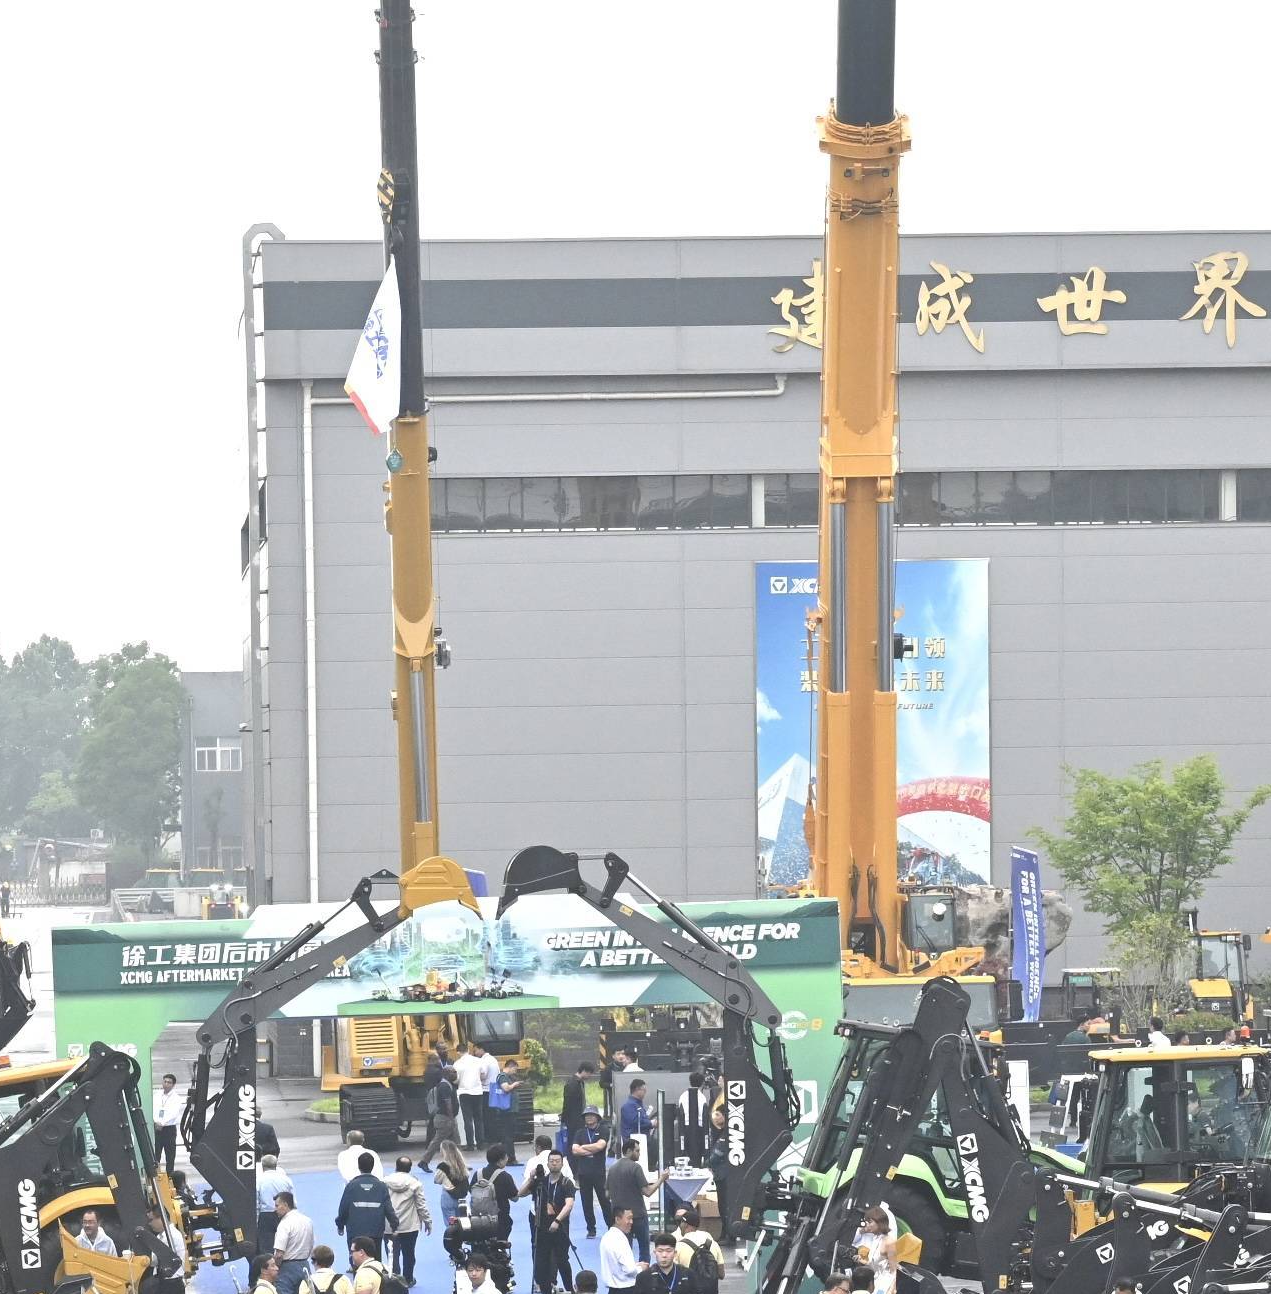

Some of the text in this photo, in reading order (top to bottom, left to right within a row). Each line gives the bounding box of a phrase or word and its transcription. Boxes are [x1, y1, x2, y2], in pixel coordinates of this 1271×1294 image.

[789, 578, 819, 594] XC
[1020, 870, 1029, 895] FOR
[544, 931, 612, 949] GREEN
[758, 923, 800, 940] FOR
[580, 949, 668, 967] A BETTE
[120, 971, 152, 985] XCMG
[156, 968, 243, 983] AFTERMARKET
[238, 1084, 256, 1150] XCMG
[728, 1100, 746, 1166] XCMG
[959, 1154, 990, 1223] XCMG
[18, 1178, 40, 1247] XCMG
